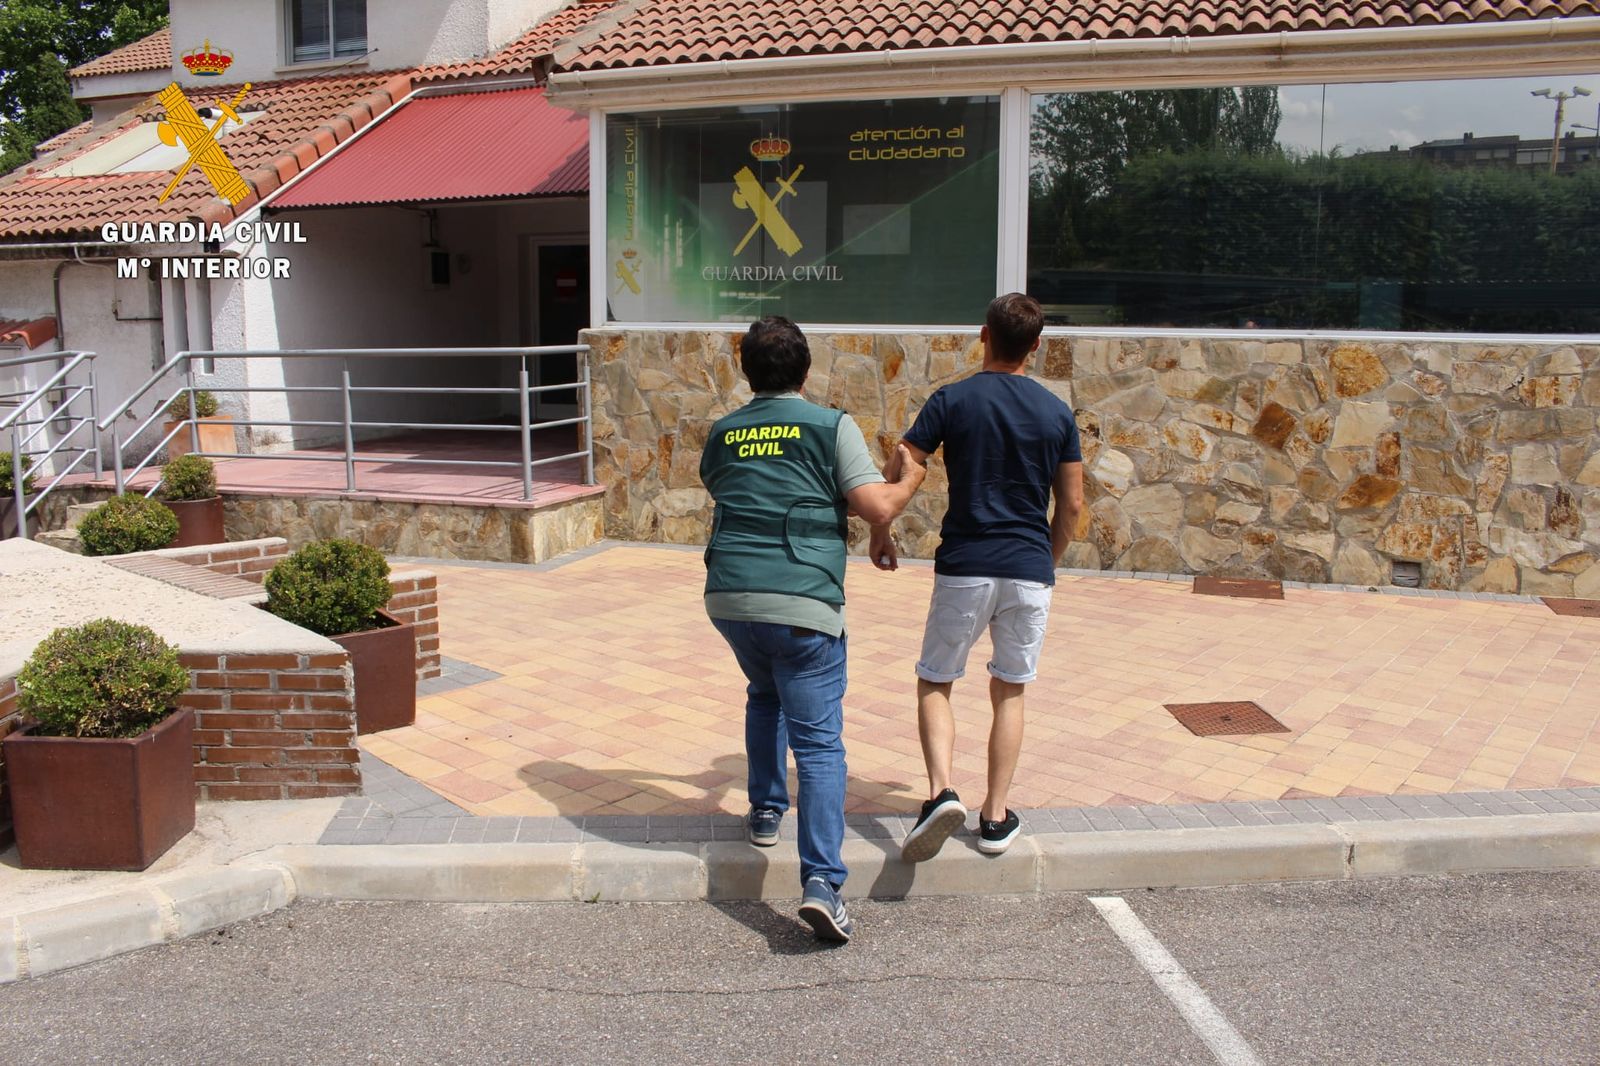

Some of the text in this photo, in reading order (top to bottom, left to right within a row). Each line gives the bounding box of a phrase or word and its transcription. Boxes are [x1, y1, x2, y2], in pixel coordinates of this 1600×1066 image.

[849, 125, 964, 141] atención al
[848, 145, 966, 161] ciudadano
[702, 265, 844, 281] GUARDIA CIVIL
[724, 426, 801, 445] GUARDIA
[738, 442, 784, 458] CIVIL
